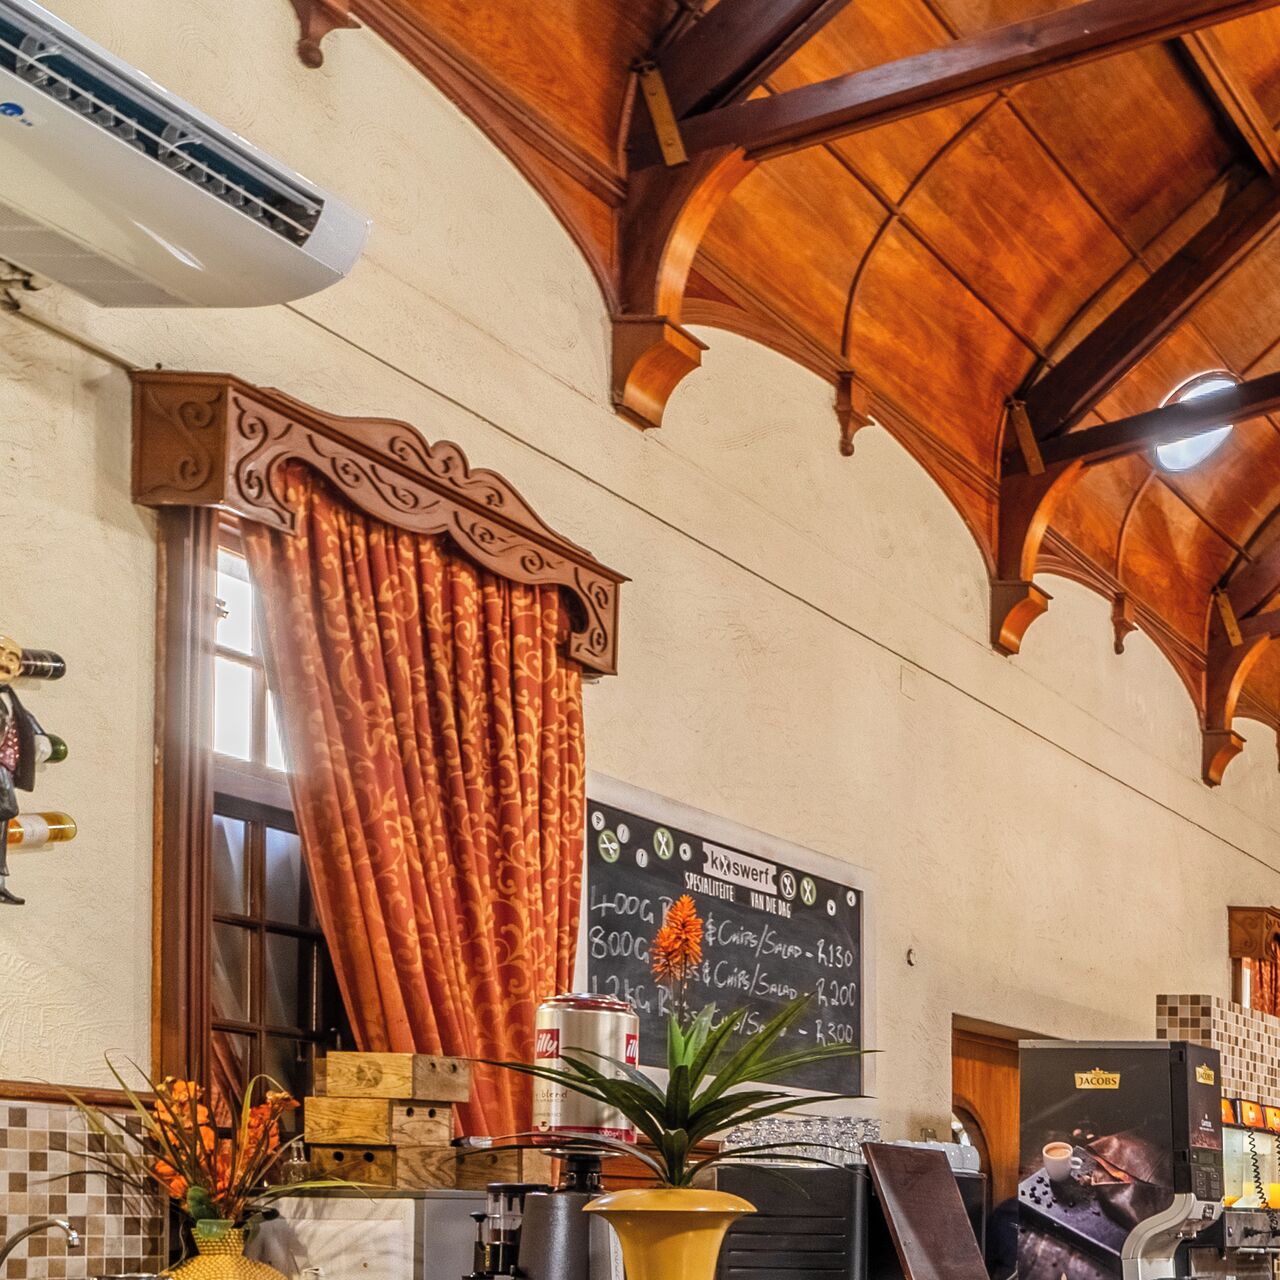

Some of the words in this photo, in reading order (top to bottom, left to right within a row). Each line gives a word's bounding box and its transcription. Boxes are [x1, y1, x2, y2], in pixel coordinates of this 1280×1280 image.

[750, 891, 764, 911] VAN
[778, 899, 791, 919] DAG
[816, 978, 856, 1007] R200
[536, 1033, 558, 1056] illy
[815, 1019, 853, 1047] R300
[626, 1039, 638, 1058] ill
[1078, 1076, 1117, 1087] JACOBS
